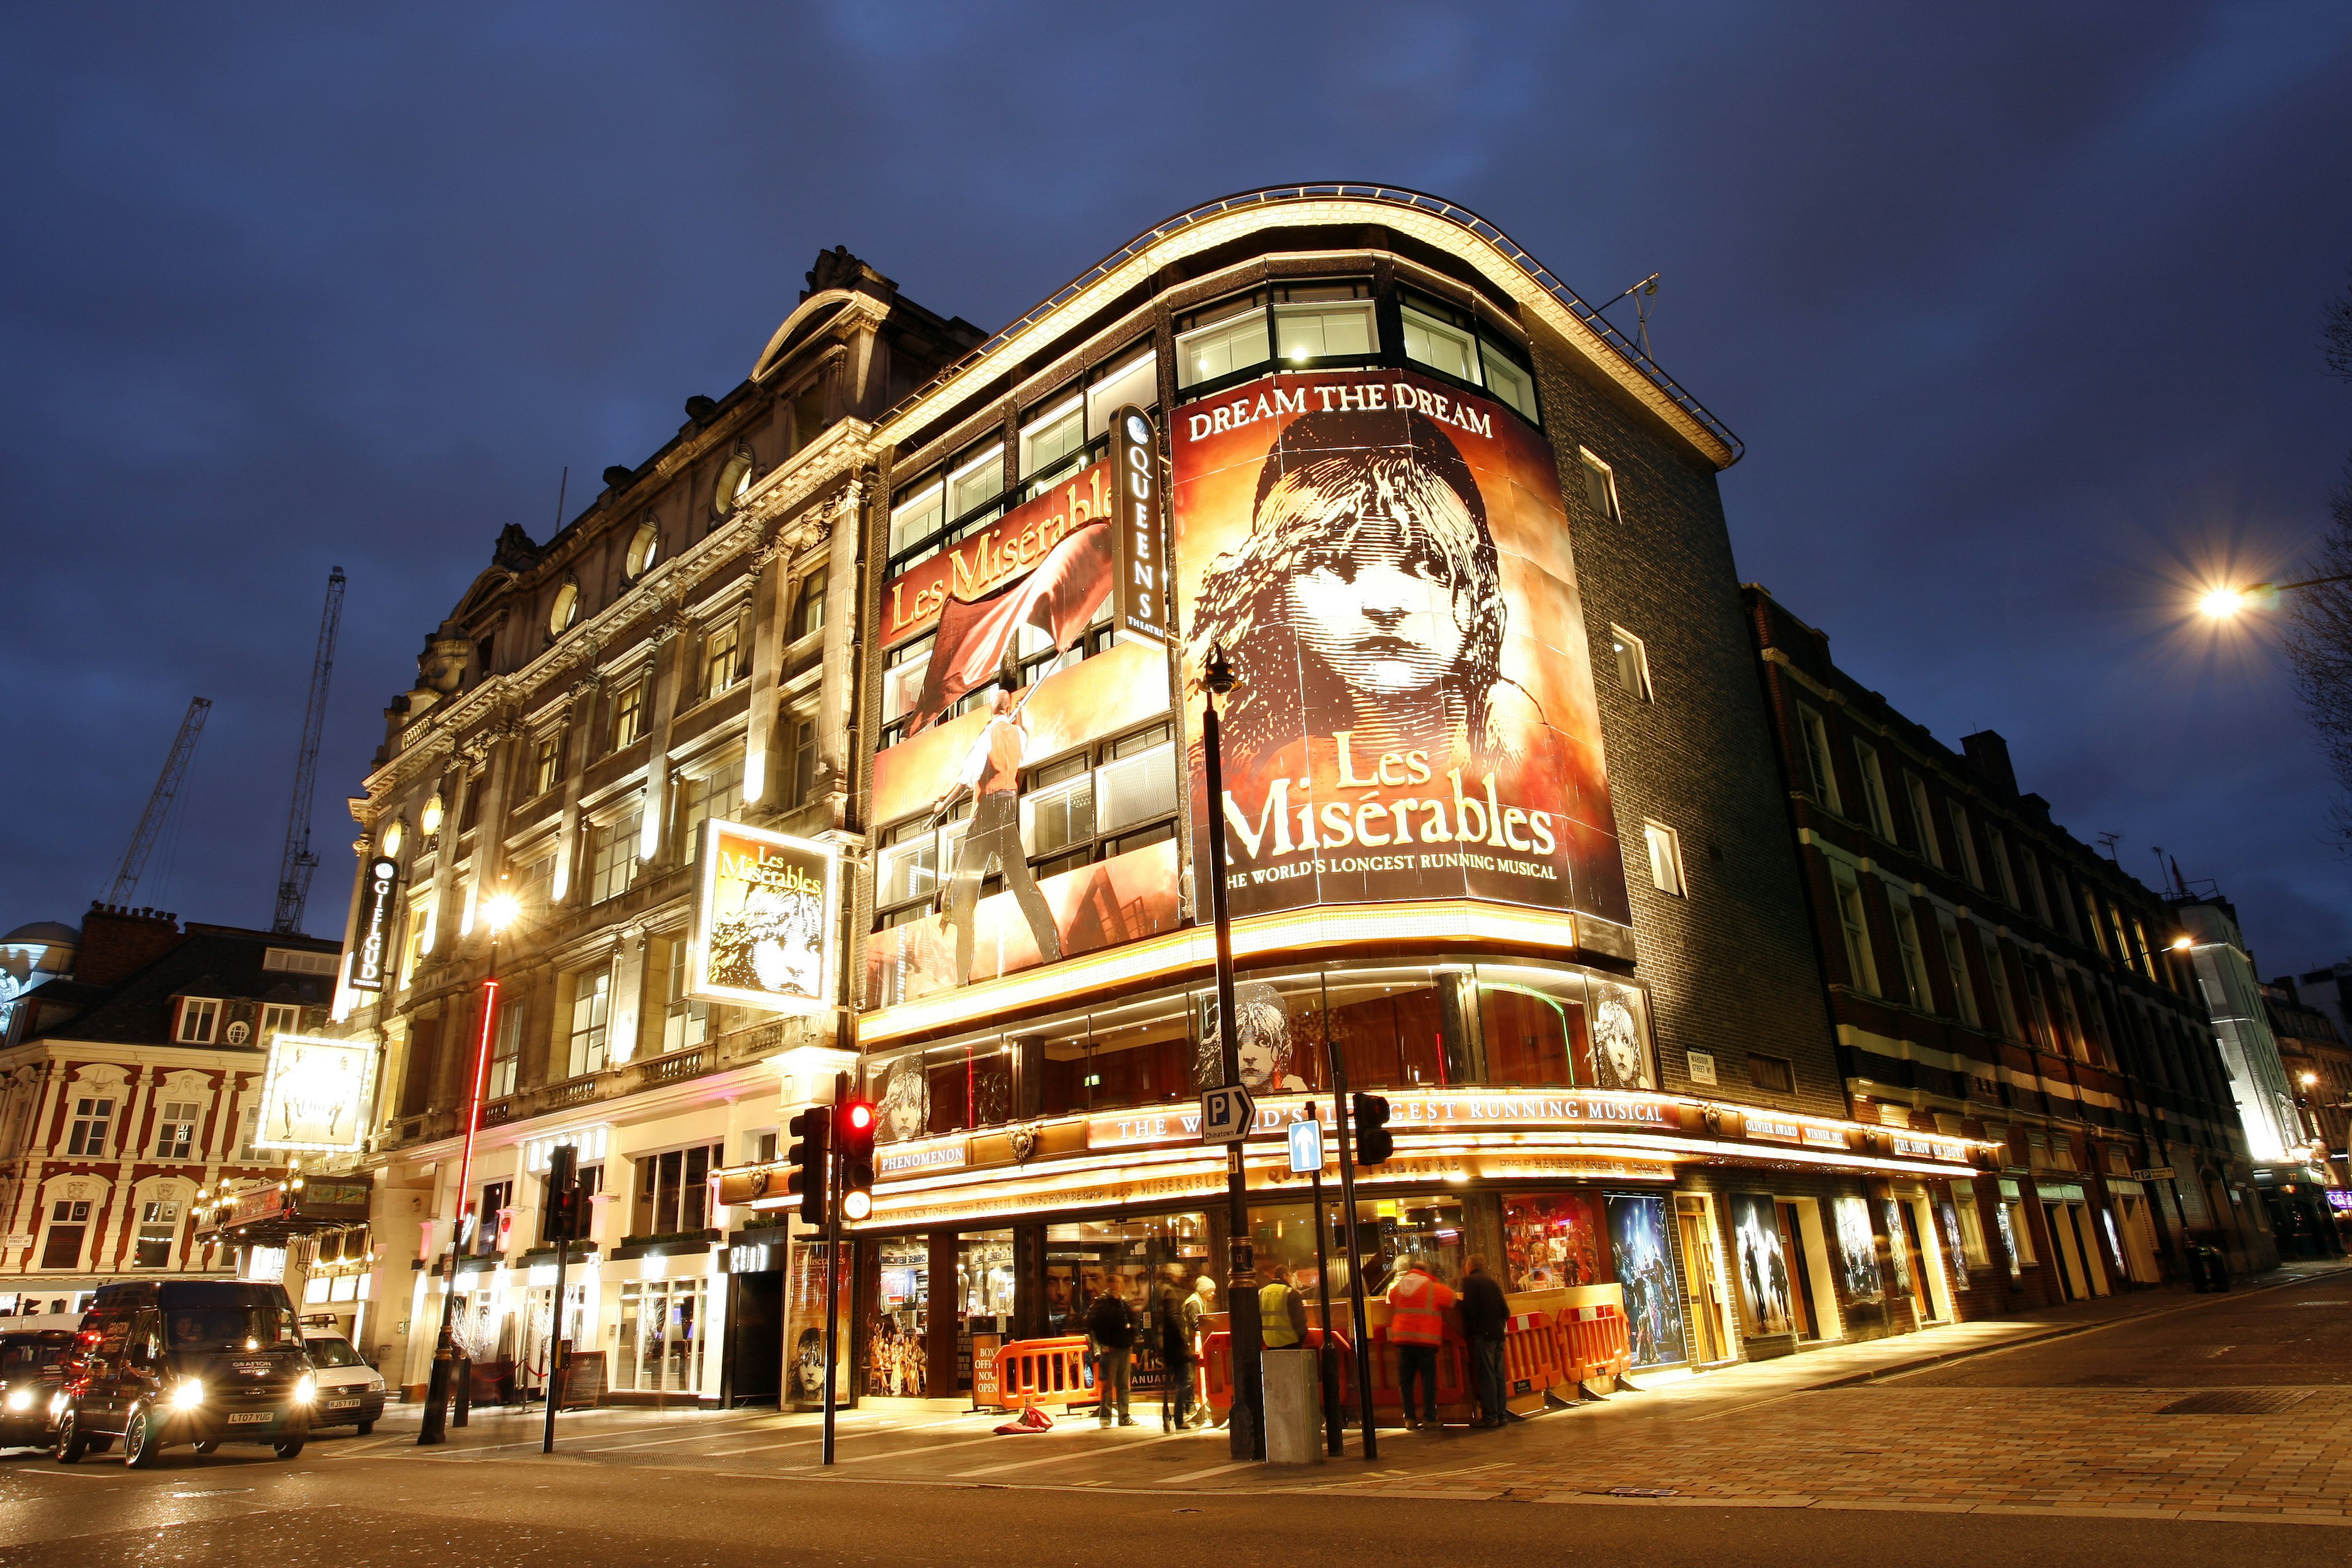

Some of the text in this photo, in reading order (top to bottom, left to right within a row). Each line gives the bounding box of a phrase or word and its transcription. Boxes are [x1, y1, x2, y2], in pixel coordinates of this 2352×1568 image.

[1189, 383, 1493, 442] DREAM THE DREAM
[1129, 447, 1153, 619] QUEENS
[890, 578, 944, 635] Les
[1128, 616, 1164, 638] THEATRE
[1332, 731, 1432, 788] Les
[1223, 767, 1556, 866] Misérables
[758, 846, 784, 869] Les
[720, 851, 821, 894] Misérables
[1226, 853, 1557, 890] HE WORLD'S LONGEST RUNNING MUSICAL
[361, 880, 390, 979] GIELGUD
[1117, 1116, 1167, 1139] THE
[1180, 1108, 1303, 1133] WD'S
[1470, 1100, 1579, 1119] RUNNING
[1588, 1102, 1664, 1122] MUSICAL
[1212, 1096, 1225, 1123] P
[1205, 1130, 1234, 1139] Chinatown
[1746, 1120, 1798, 1137] OLIVIER AWARD
[1804, 1128, 1843, 1142] WINNER 2012
[1910, 1141, 1930, 1154] SHOW
[1933, 1144, 1942, 1156] OF
[882, 1147, 964, 1171] PHENOMENON
[1368, 1159, 1460, 1175] THEATRE
[1533, 1160, 1582, 1170] HERBERT
[1016, 1196, 1035, 1207] AND
[1111, 1185, 1133, 1198] LES
[980, 1348, 995, 1357] BOX
[974, 1359, 998, 1369] OFFI
[978, 1383, 998, 1393] OPEN
